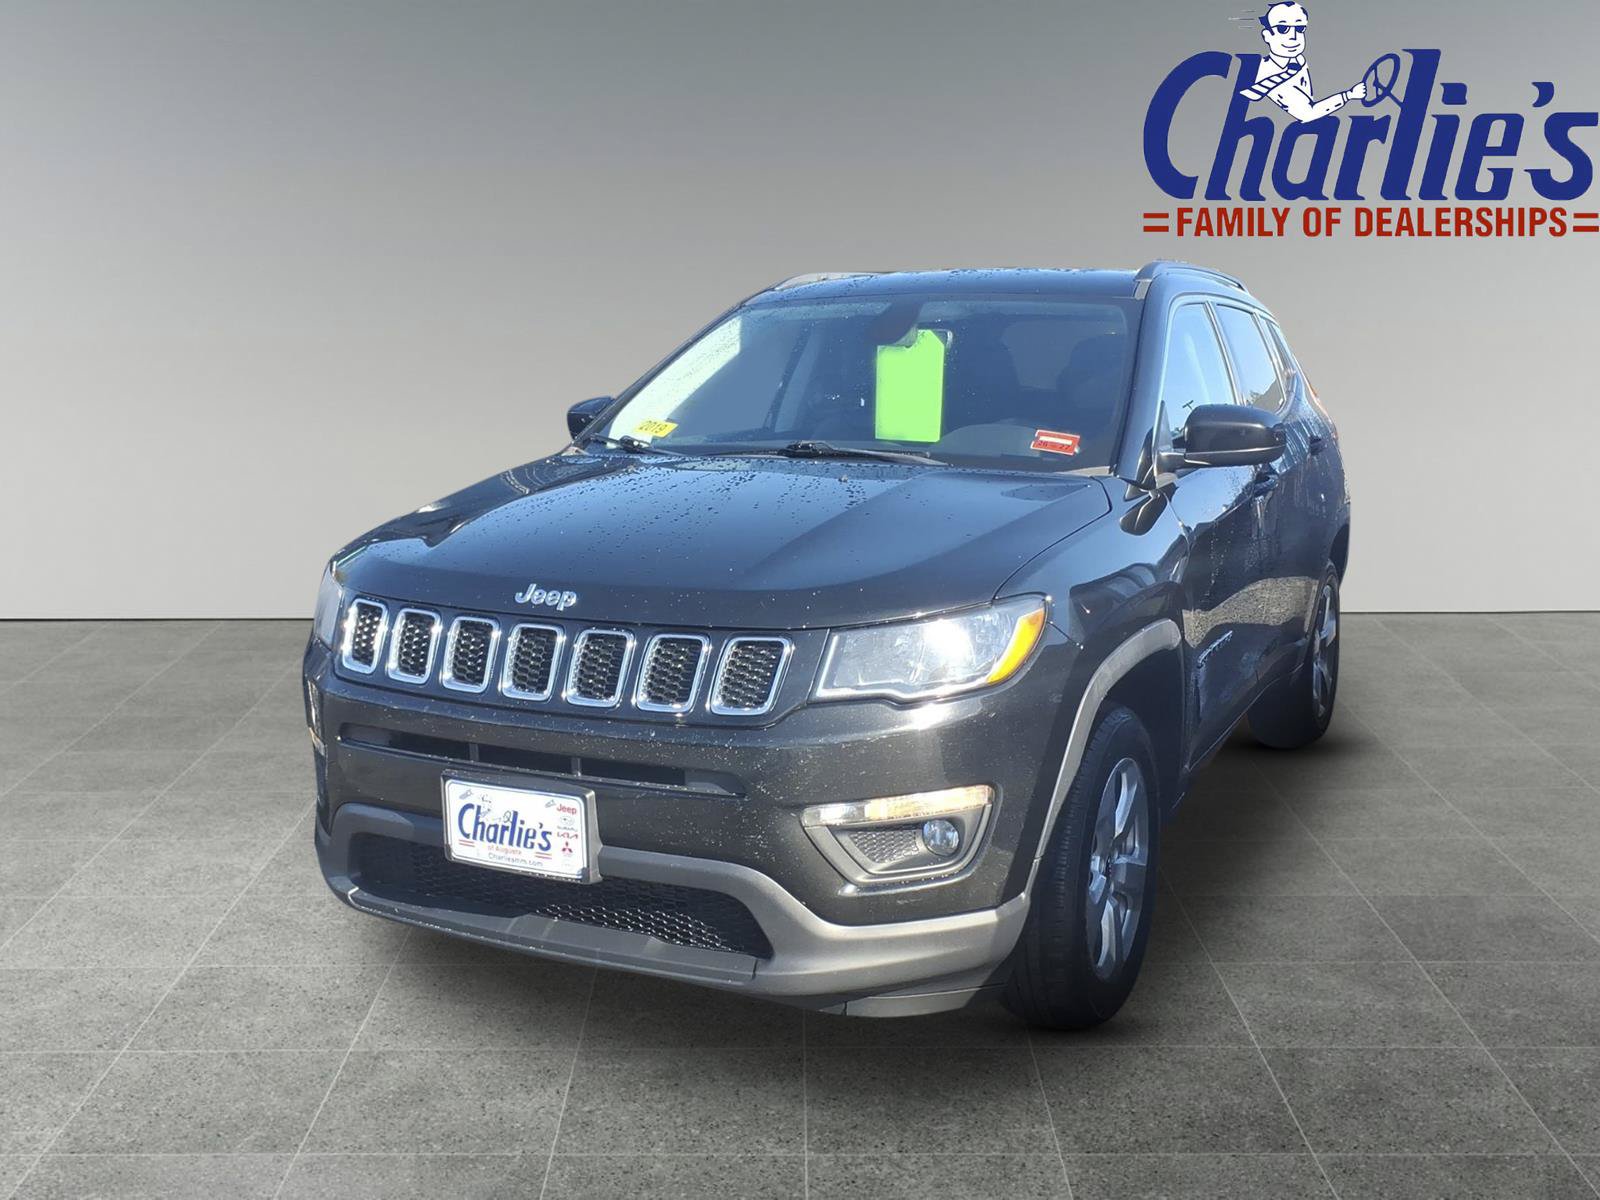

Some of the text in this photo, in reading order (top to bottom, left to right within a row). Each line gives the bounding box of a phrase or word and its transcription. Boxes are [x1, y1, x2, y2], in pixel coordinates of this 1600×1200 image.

[639, 420, 668, 434] 2019
[514, 583, 577, 611] Jeep
[557, 803, 577, 815] Jeep
[458, 802, 552, 852] Charlie's
